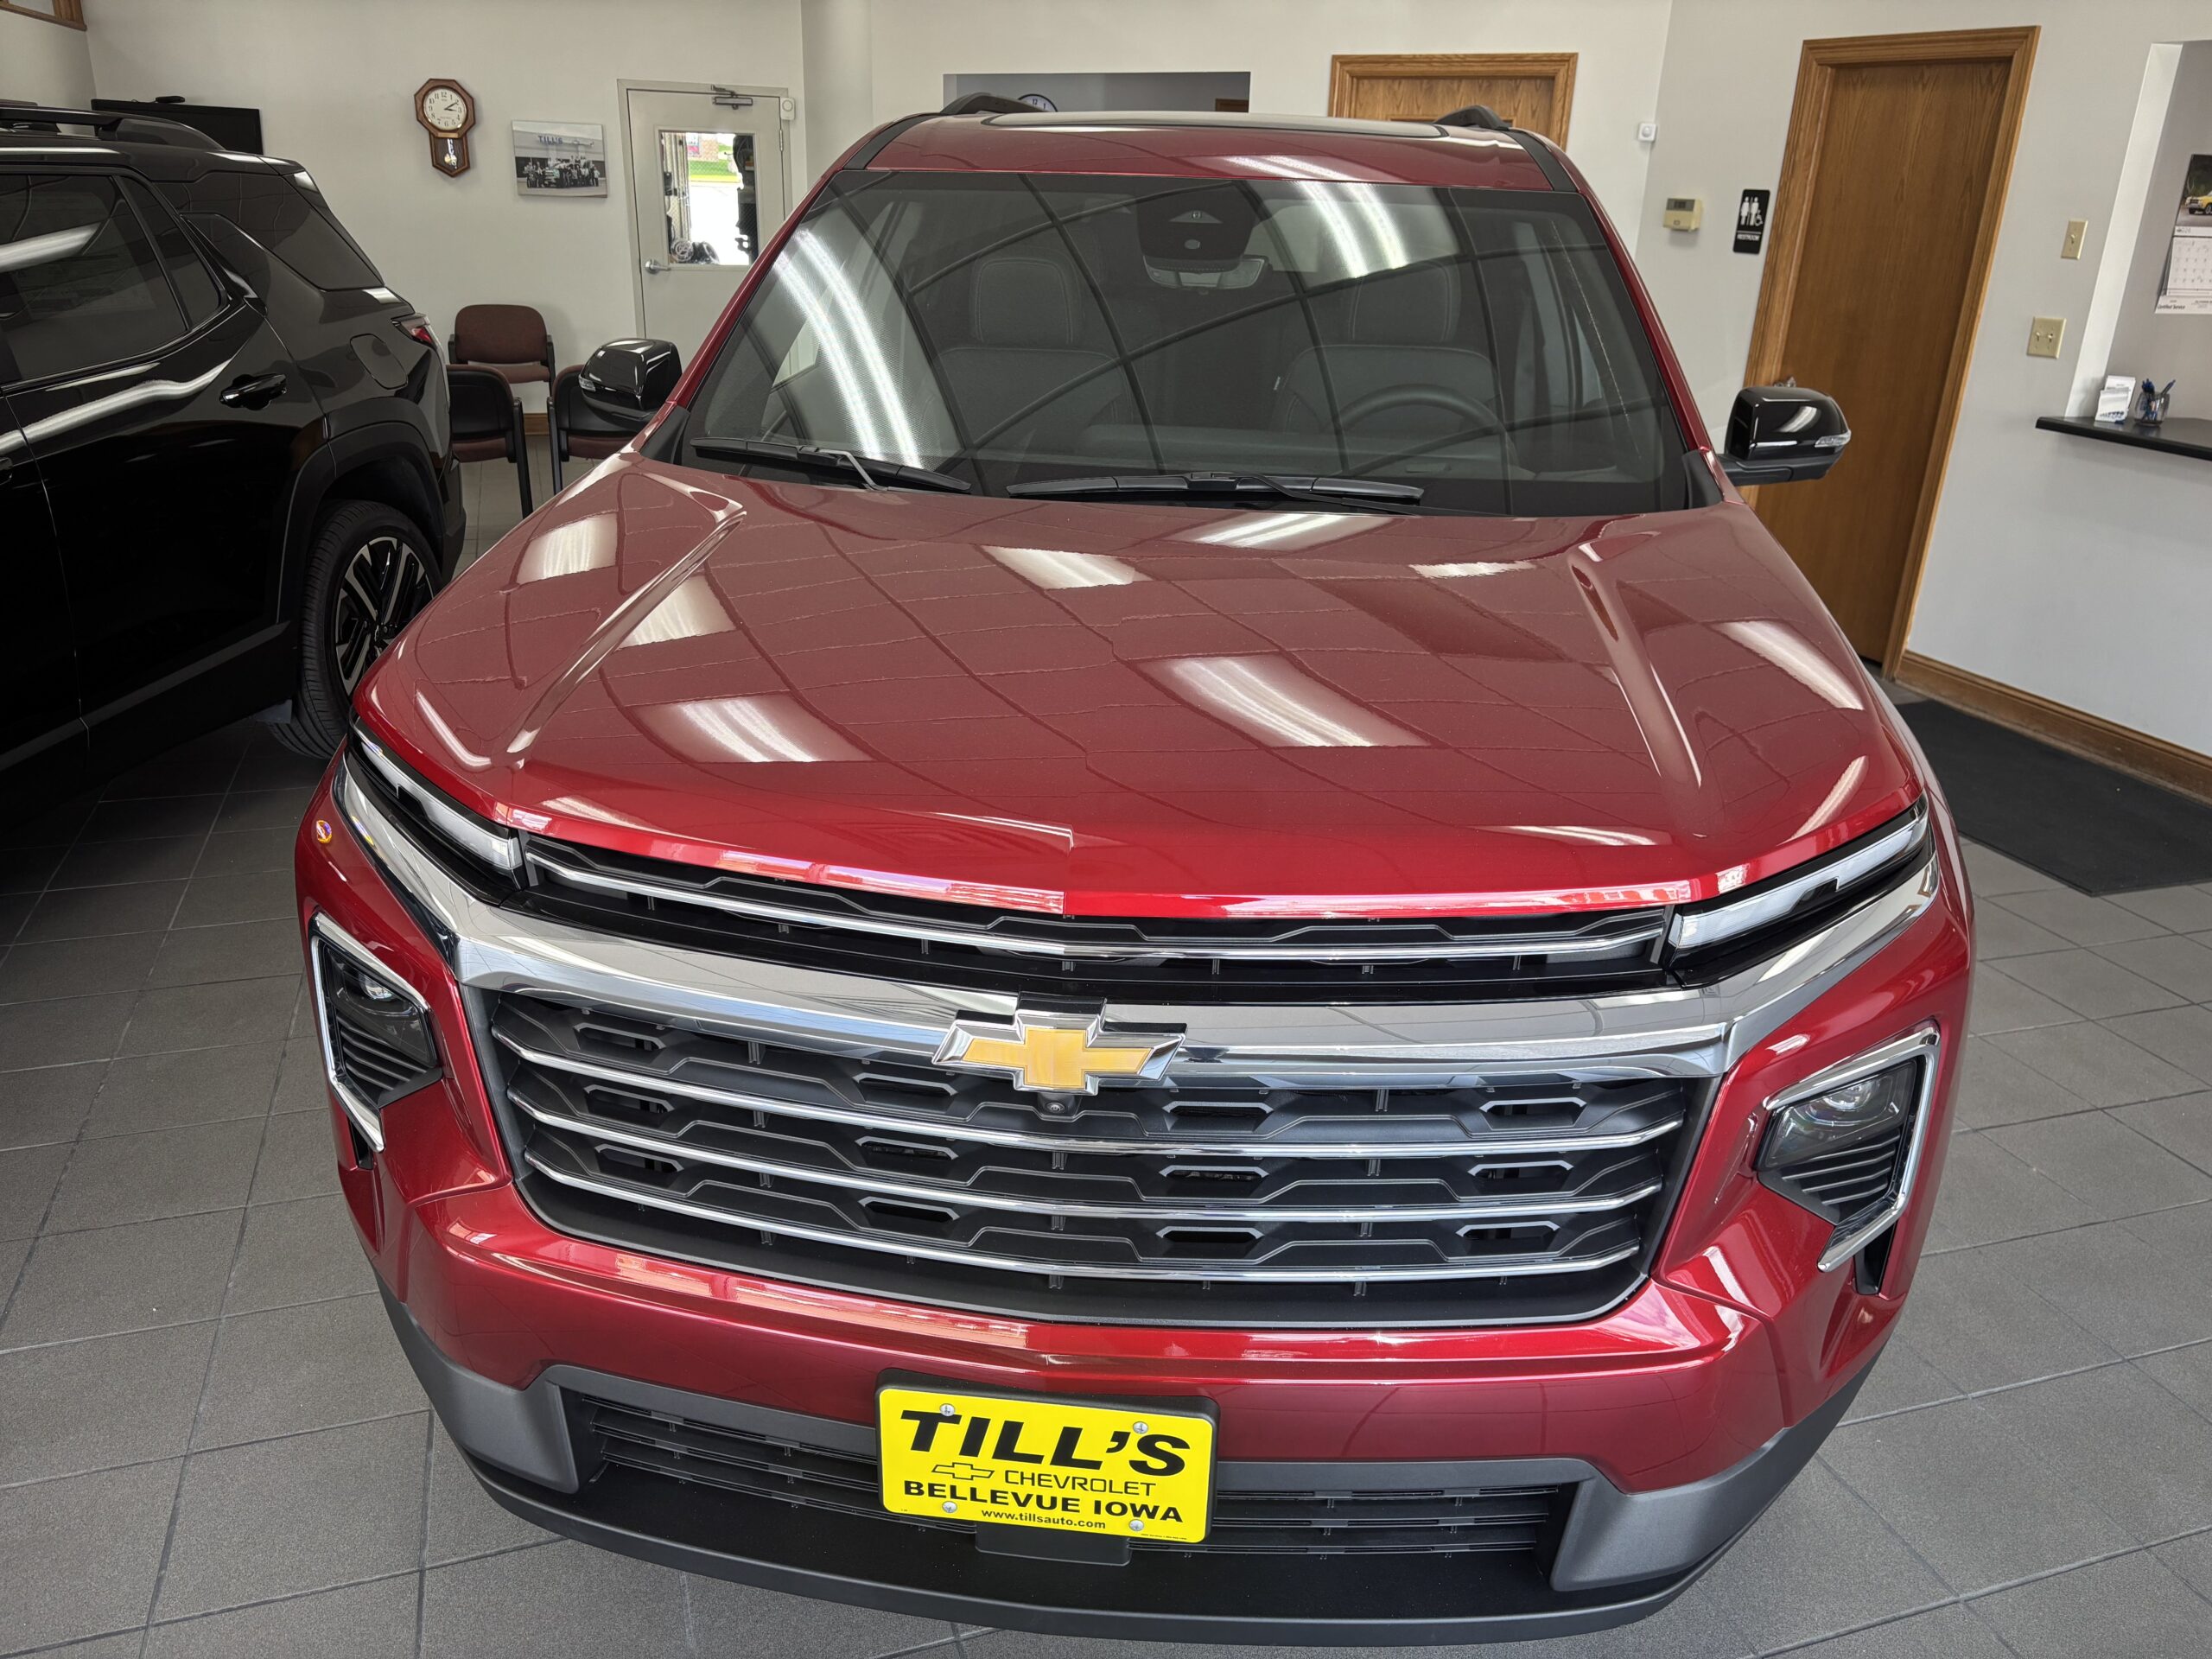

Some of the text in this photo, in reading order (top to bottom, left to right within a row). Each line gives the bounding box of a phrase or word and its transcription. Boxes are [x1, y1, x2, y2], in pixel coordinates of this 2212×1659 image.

[900, 1409, 1191, 1477] TILL'S
[1004, 1470, 1156, 1497] CHEVROLET
[904, 1480, 1184, 1523] BELLEVUE IOWA
[981, 1509, 1106, 1529] www.tillsauto.com
